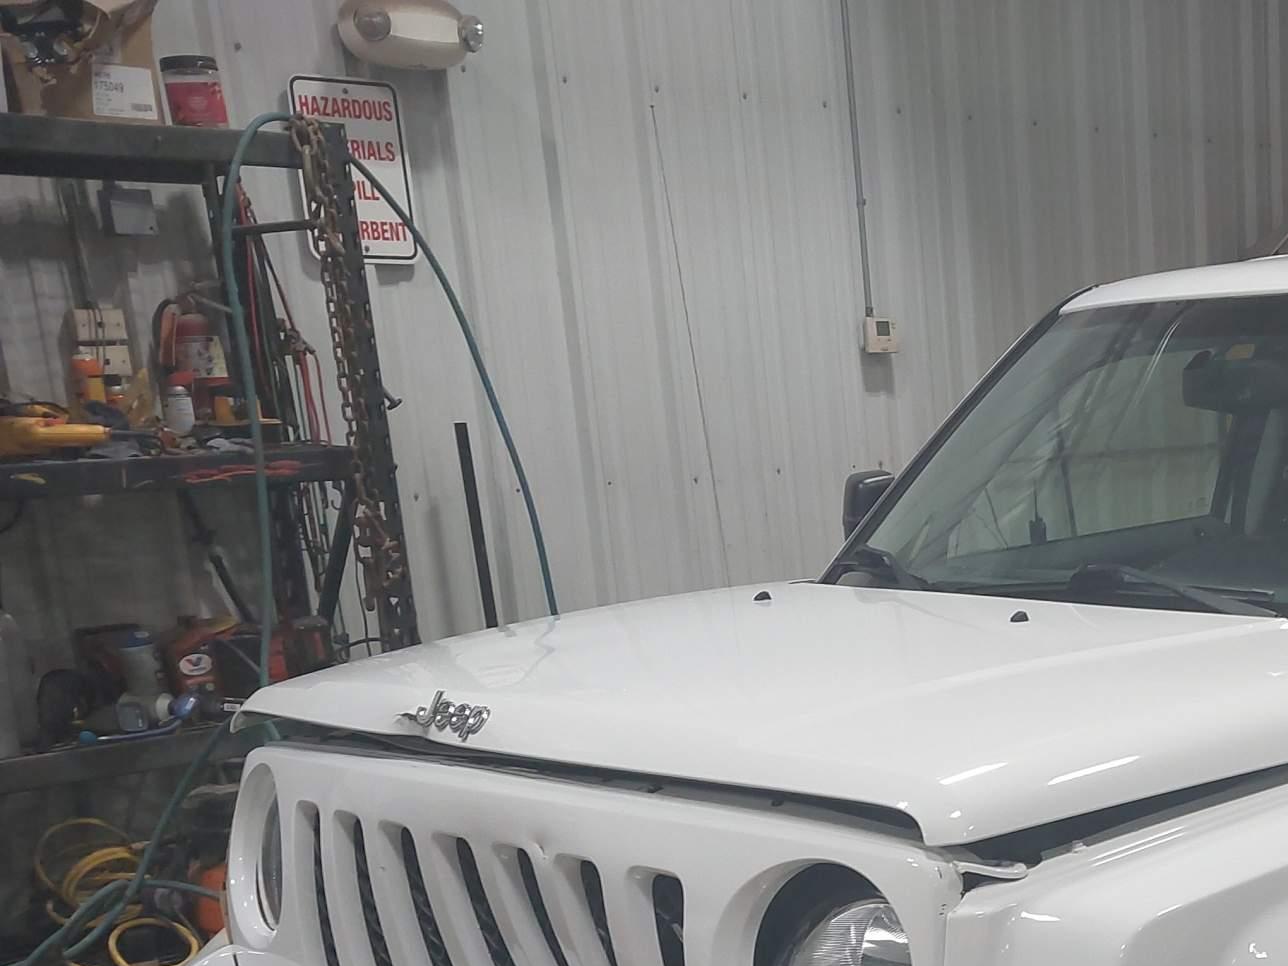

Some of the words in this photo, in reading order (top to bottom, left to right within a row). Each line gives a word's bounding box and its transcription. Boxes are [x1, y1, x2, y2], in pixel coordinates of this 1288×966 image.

[298, 94, 393, 121] HAZARDOUS
[348, 139, 396, 162] RIALS
[358, 220, 408, 242] RBENT
[416, 690, 490, 742] Jeep
